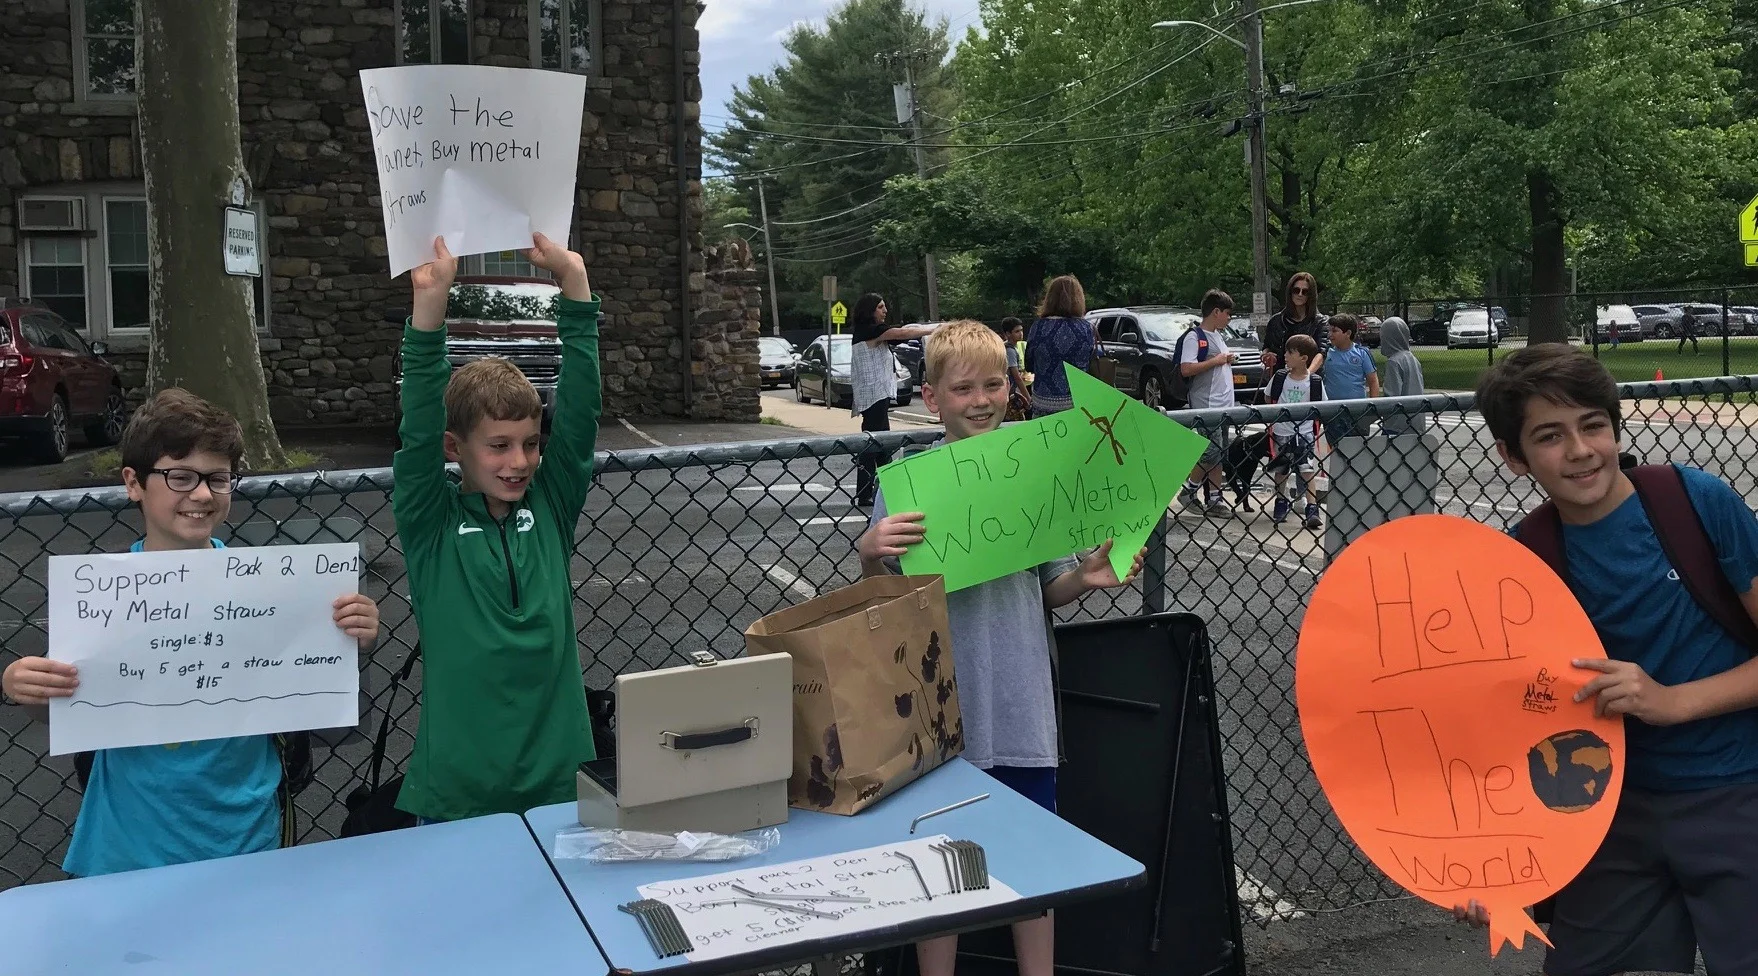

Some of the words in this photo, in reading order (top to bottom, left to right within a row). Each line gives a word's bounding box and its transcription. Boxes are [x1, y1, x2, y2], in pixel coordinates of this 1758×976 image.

[368, 86, 423, 137] Save
[450, 93, 513, 127] the
[432, 140, 459, 161] Buy
[228, 227, 254, 241] RESERVED
[229, 244, 255, 257] PARKING
[881, 438, 1022, 507] This
[1037, 419, 1068, 450] to
[921, 503, 1046, 563] Way
[1049, 459, 1158, 530] Metal
[74, 563, 190, 601] Support
[281, 555, 295, 577] 2
[77, 600, 112, 628] Buy
[126, 600, 189, 622] Metal
[1367, 552, 1535, 670] Help
[119, 662, 145, 680] Buy
[159, 661, 168, 675] 5
[178, 660, 204, 677] get
[221, 660, 230, 670] a
[243, 654, 283, 668] straw
[294, 653, 343, 667] cleaner
[1536, 667, 1559, 684] Buy
[196, 676, 223, 690] $15
[1524, 683, 1559, 702] Metal
[1357, 706, 1525, 832] The
[646, 877, 745, 899] Support
[833, 857, 868, 867] Den
[755, 878, 825, 897] etal
[695, 927, 733, 945] get
[745, 922, 764, 933] 5
